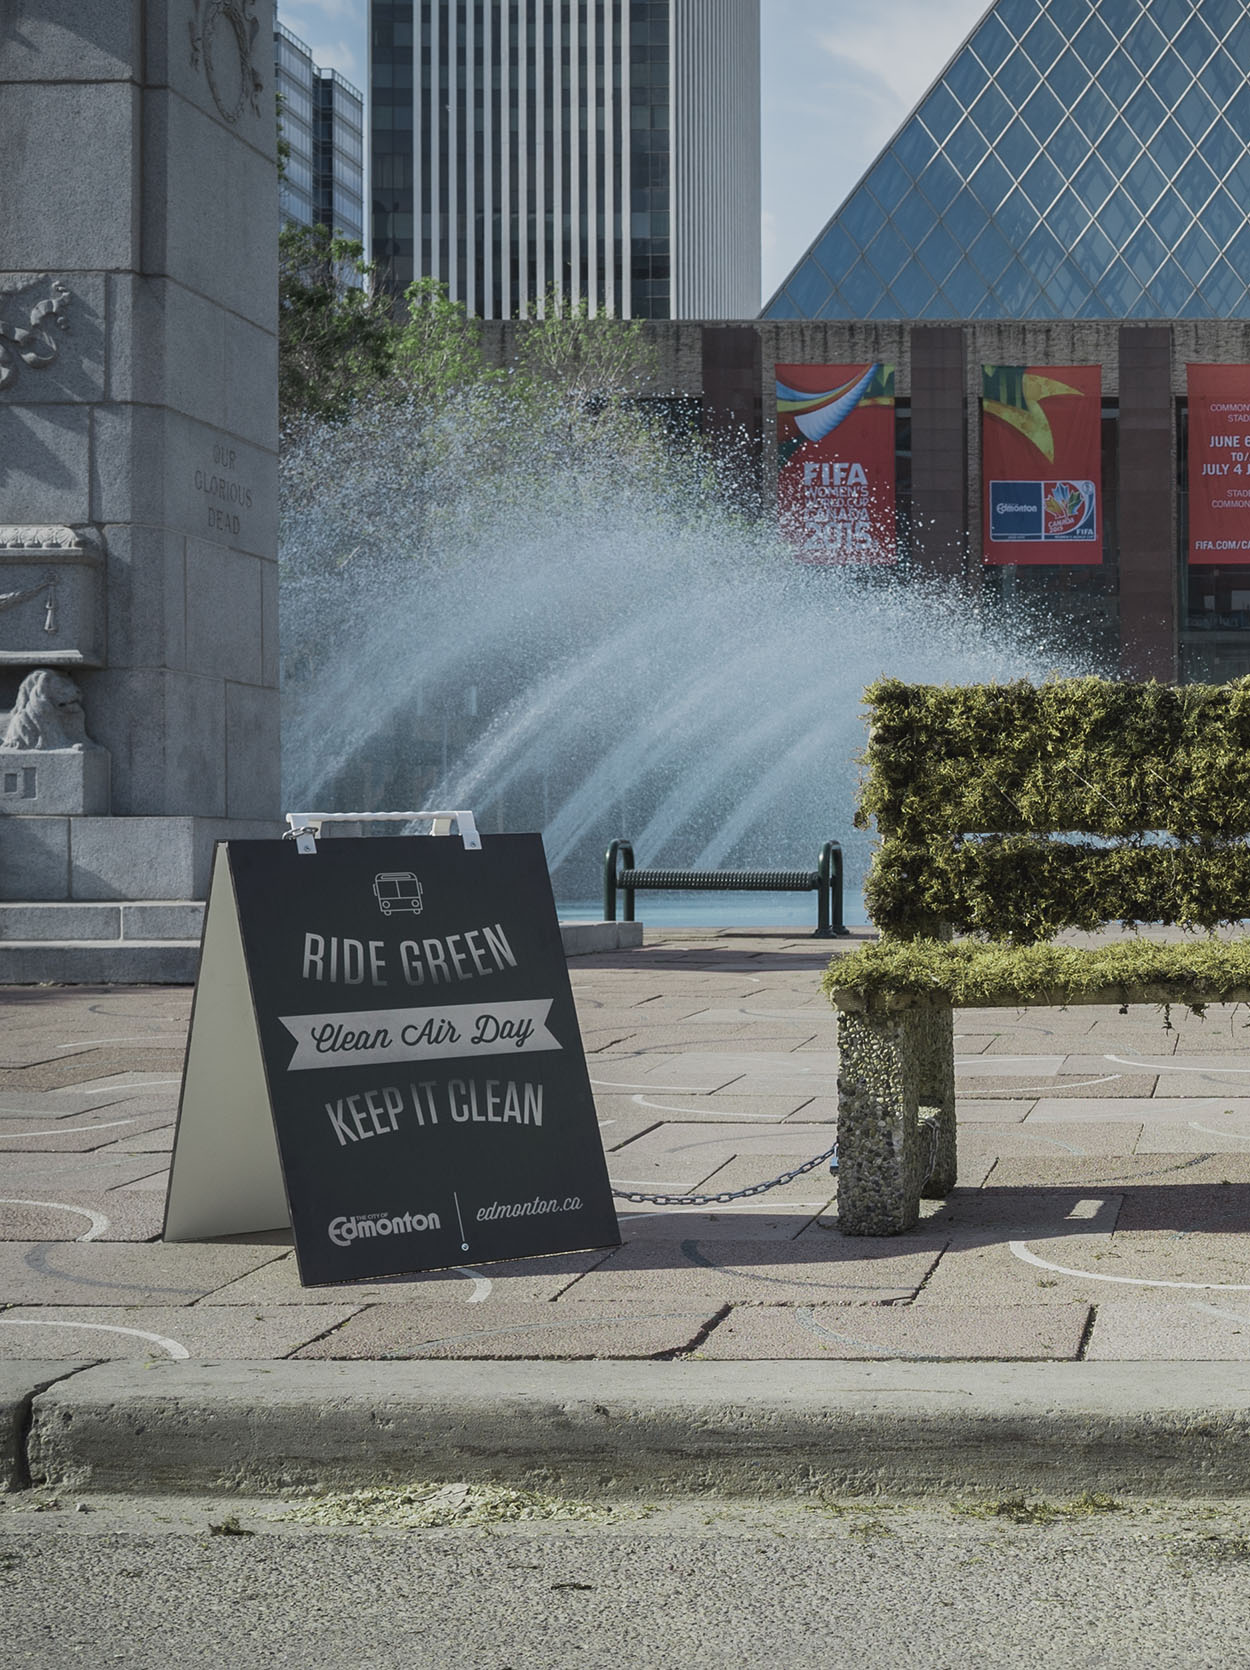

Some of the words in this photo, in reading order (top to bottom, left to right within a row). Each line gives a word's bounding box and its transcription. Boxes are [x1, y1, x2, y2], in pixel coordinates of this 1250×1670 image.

[1209, 436, 1240, 448] JUNE
[213, 444, 236, 470] OUR
[1201, 464, 1230, 475] JULY
[1233, 464, 1242, 475] 4
[803, 463, 869, 486] FIFA
[195, 470, 252, 508] GLORIOUS
[804, 486, 869, 497] WOMEN'S
[847, 497, 869, 507] CUP
[208, 506, 240, 534] DEAD
[996, 503, 1037, 514] Edmonton
[804, 521, 873, 551] 2015
[303, 932, 388, 987] RIDE
[400, 924, 517, 987] GREEN
[311, 1023, 392, 1053] Clean
[401, 1019, 461, 1046] Air
[471, 1014, 534, 1047] Day
[325, 1083, 403, 1146] KEEP
[412, 1081, 438, 1126] IT
[448, 1079, 544, 1126] CLEAN
[476, 1196, 583, 1222] edmonton.ca
[328, 1211, 440, 1247] Edmonton
